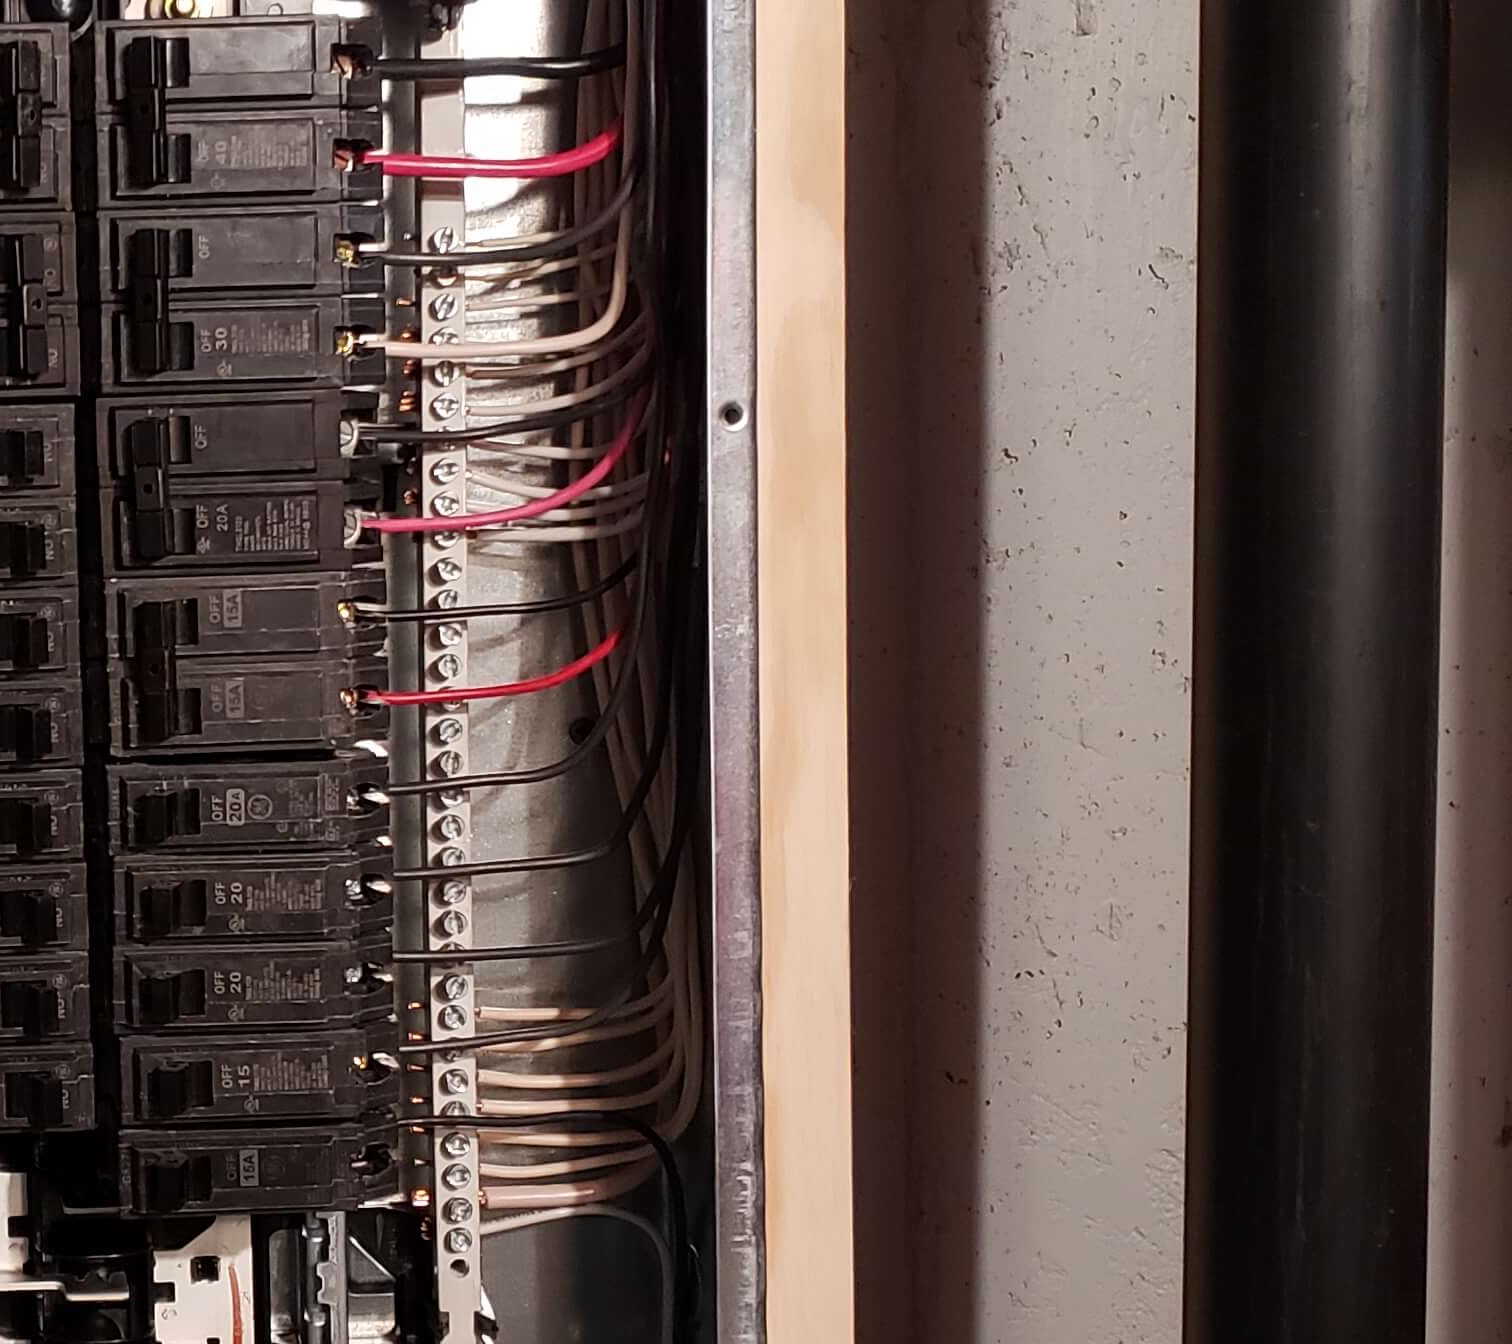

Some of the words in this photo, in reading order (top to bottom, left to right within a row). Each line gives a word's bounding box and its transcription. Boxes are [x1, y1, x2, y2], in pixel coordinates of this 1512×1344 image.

[214, 140, 227, 165] 40
[198, 234, 211, 260] OFF
[199, 327, 213, 353] OFF
[214, 327, 228, 352] 30
[194, 424, 208, 450] OFF
[195, 503, 209, 529] OFF
[215, 503, 229, 533] 20A
[208, 595, 222, 624] OFF
[226, 593, 239, 624] 15A
[210, 684, 224, 714] OFF
[228, 684, 242, 714] 15A
[211, 795, 224, 822] OFF
[229, 792, 242, 822] 20A
[215, 880, 227, 906] OFF
[229, 881, 244, 905] 20
[213, 970, 227, 995] OFF
[228, 971, 243, 995] 20
[220, 1063, 234, 1089] OFF
[236, 1064, 251, 1088] 15
[225, 1156, 238, 1182] OFF
